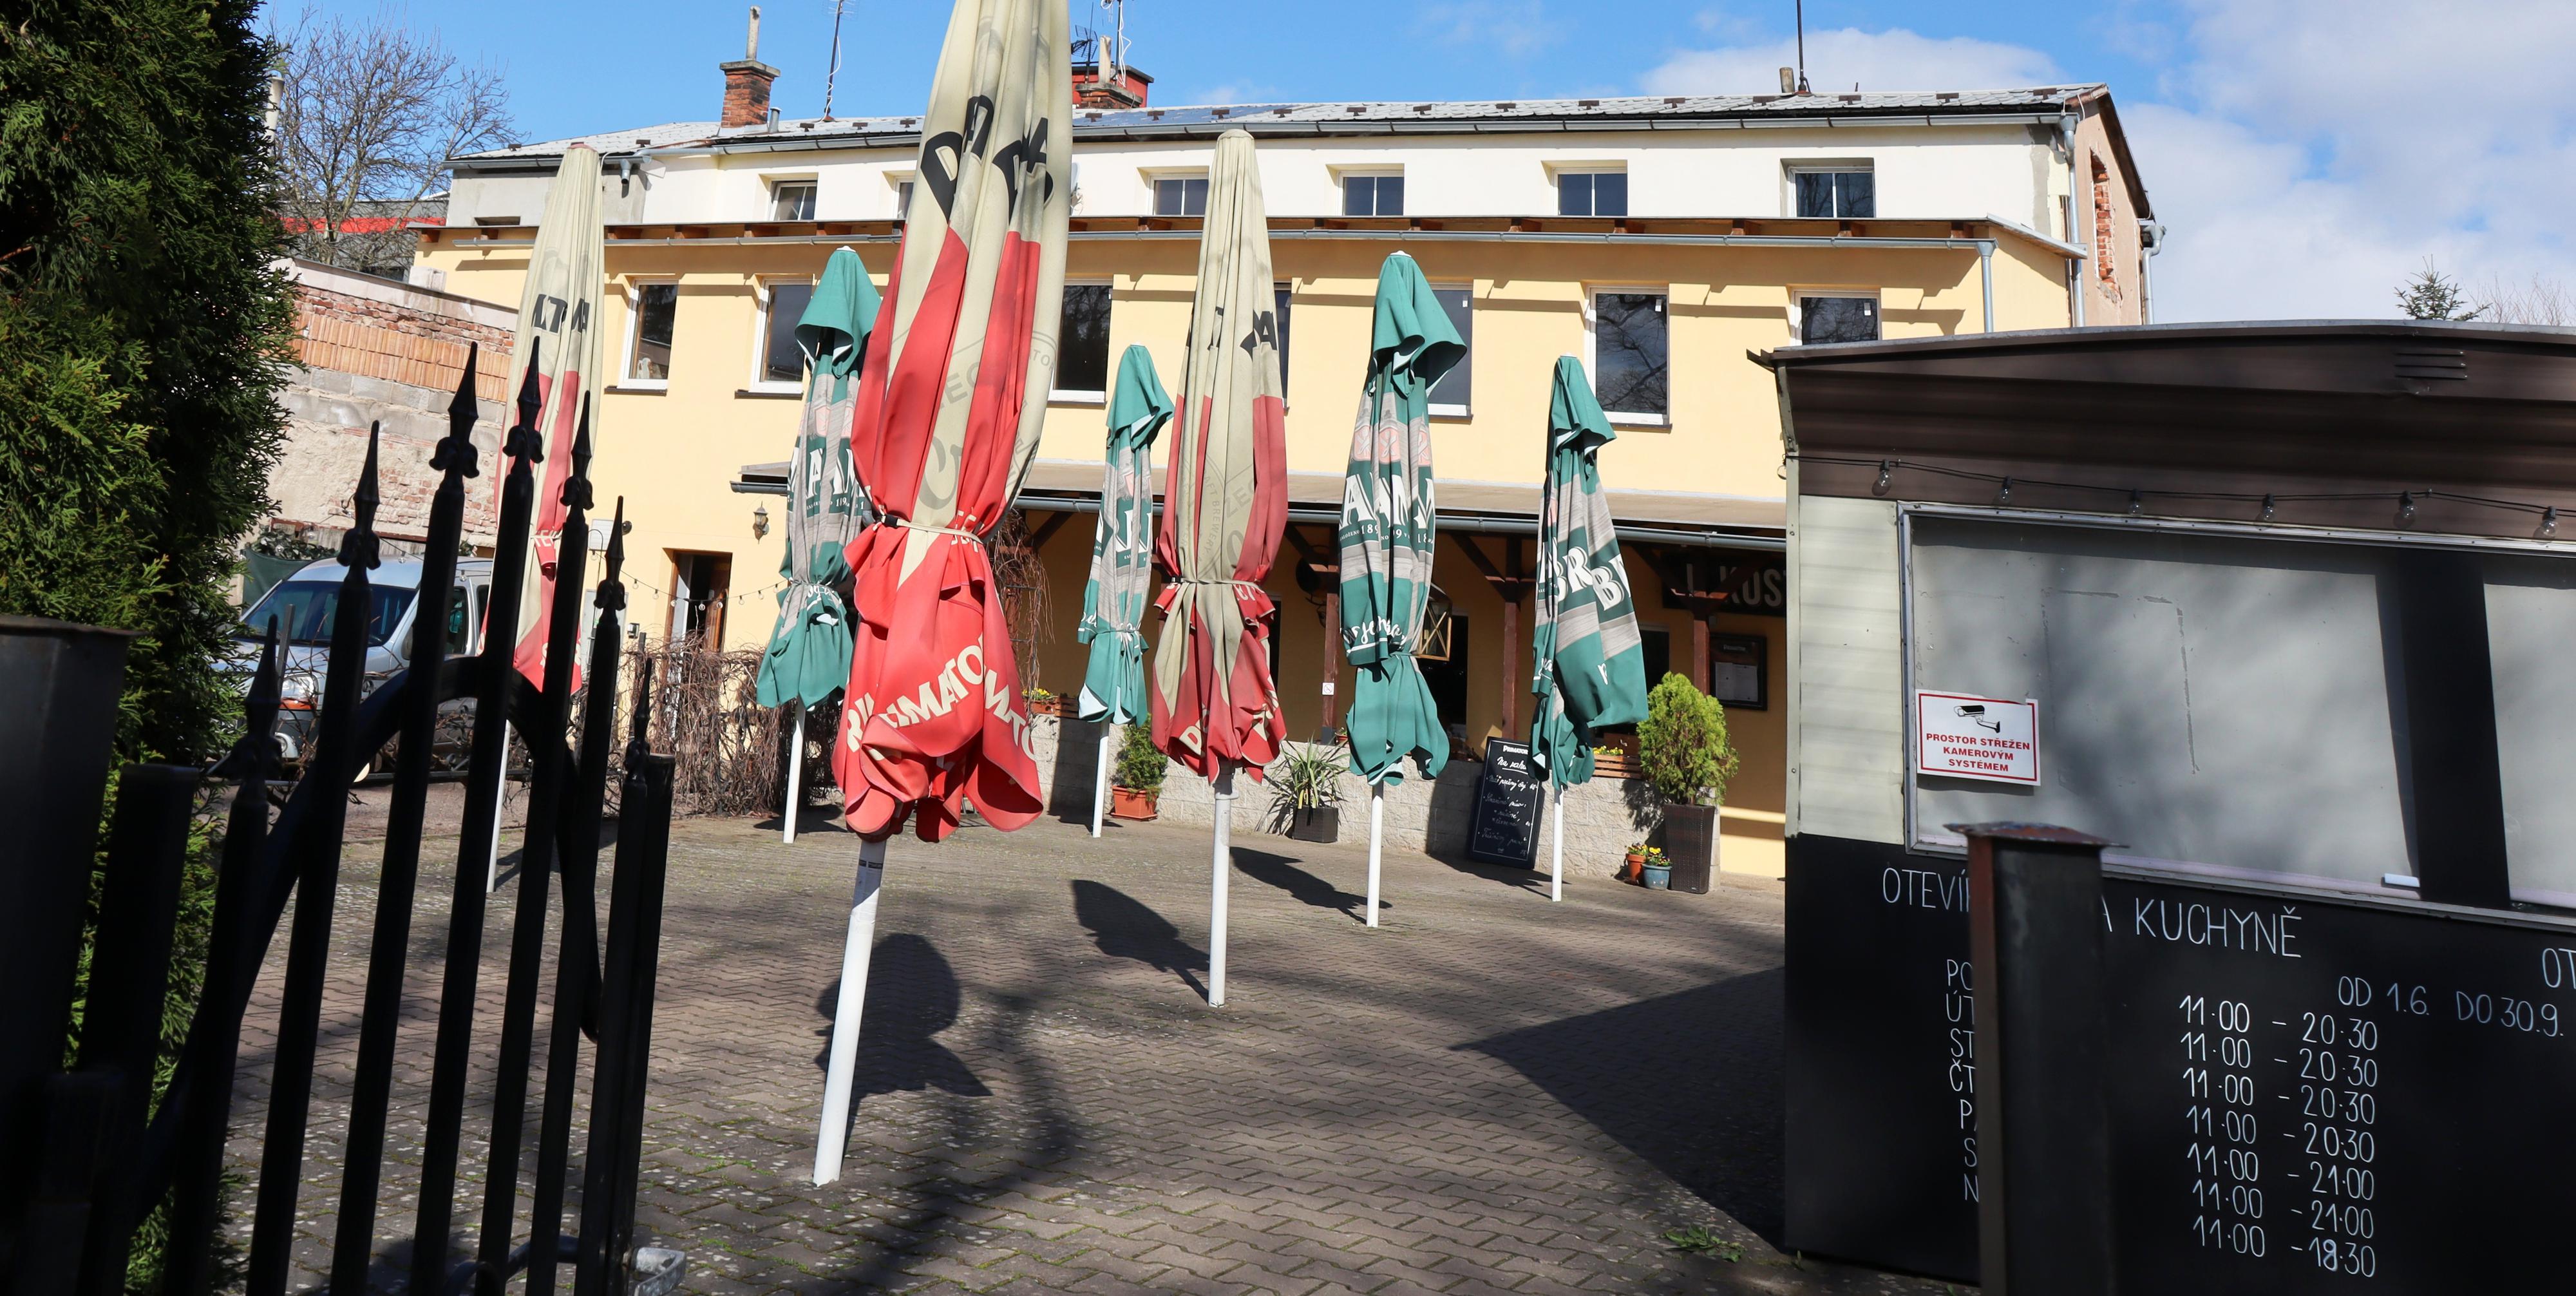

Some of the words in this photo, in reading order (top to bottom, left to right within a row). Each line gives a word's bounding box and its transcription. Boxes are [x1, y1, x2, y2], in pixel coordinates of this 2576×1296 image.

[1926, 733, 1976, 745] PROSTOR
[1980, 738, 2030, 750] STŘEŽEN
[1943, 747, 2014, 761] KAMEROVÝM
[1949, 759, 2009, 772] SYSTÉMEM
[1882, 868, 1971, 912] OTEVÍ
[2136, 897, 2302, 958] KUCHYNĚ
[2338, 976, 2371, 1006] OD
[2387, 983, 2429, 1015] 1.6.
[2456, 991, 2492, 1023] DO
[2501, 997, 2564, 1036] 30.9.
[1949, 1028, 1976, 1059] ST
[1949, 1058, 1976, 1094] ČT
[1960, 1099, 1978, 1132] P
